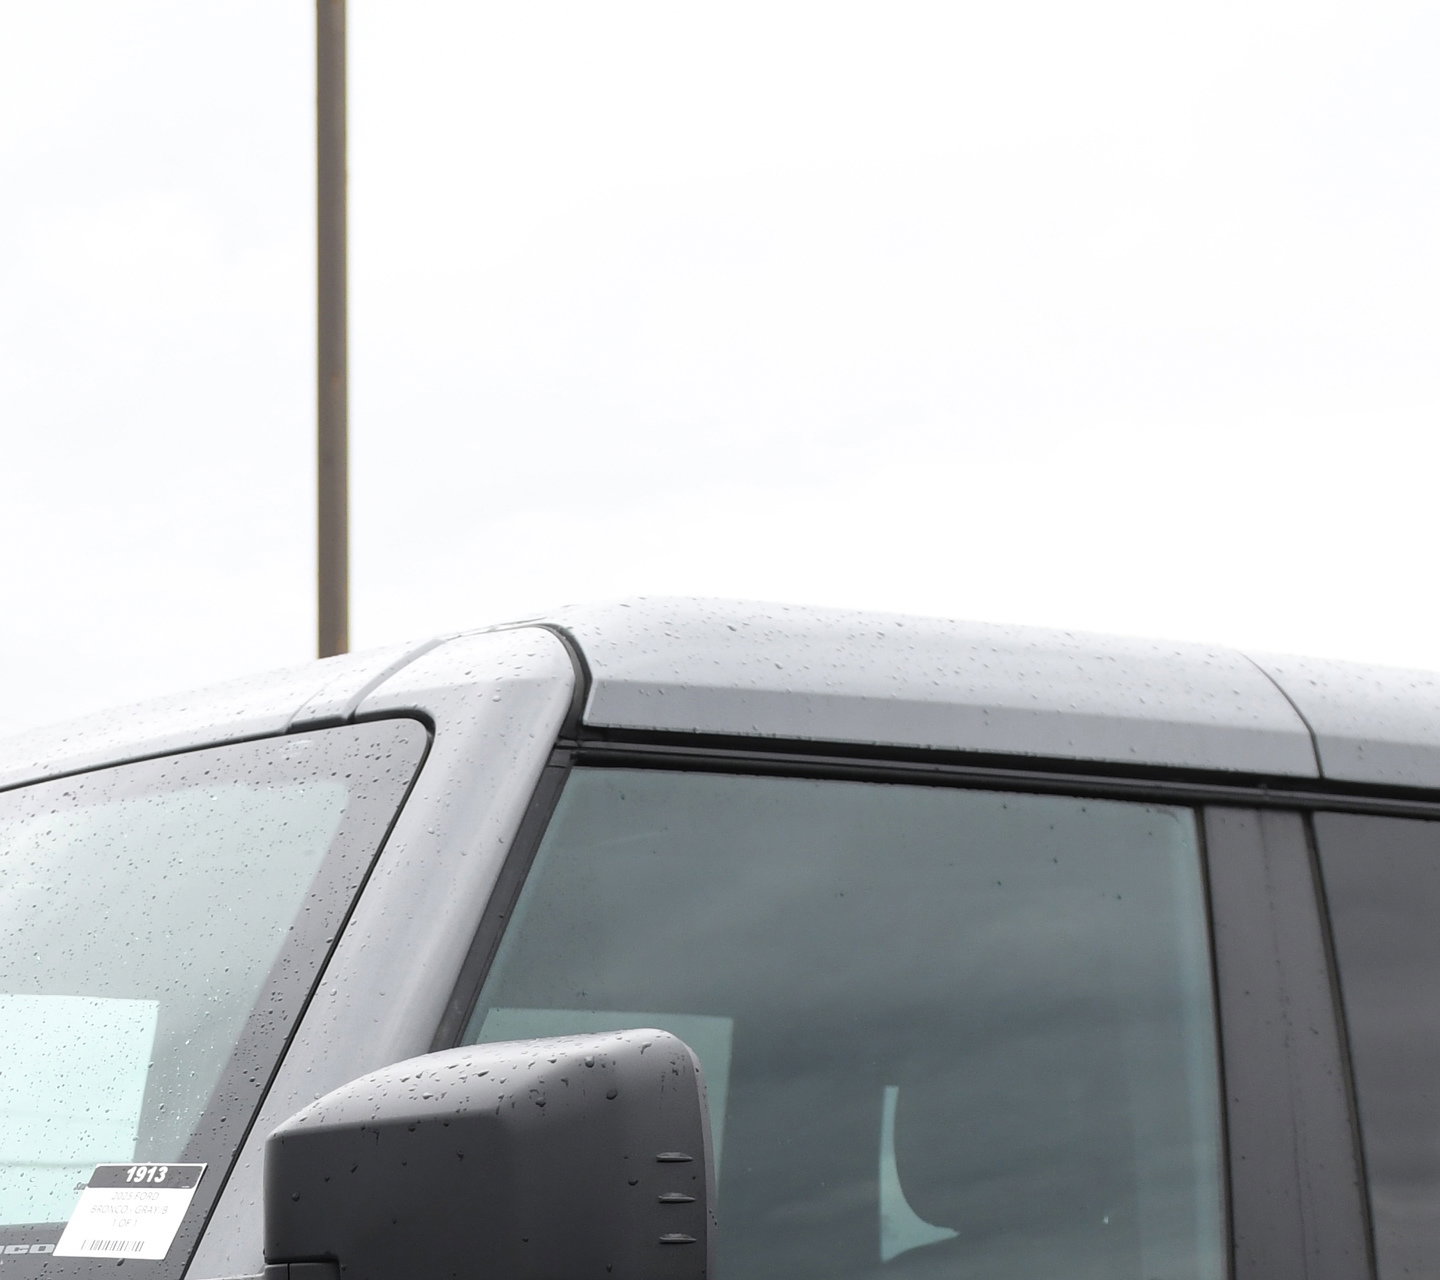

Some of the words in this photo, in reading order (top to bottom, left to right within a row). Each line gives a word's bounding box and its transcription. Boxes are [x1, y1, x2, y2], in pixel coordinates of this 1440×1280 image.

[126, 1166, 168, 1183] 1913
[134, 1191, 160, 1201] FORD
[89, 1204, 129, 1215] BRONCO
